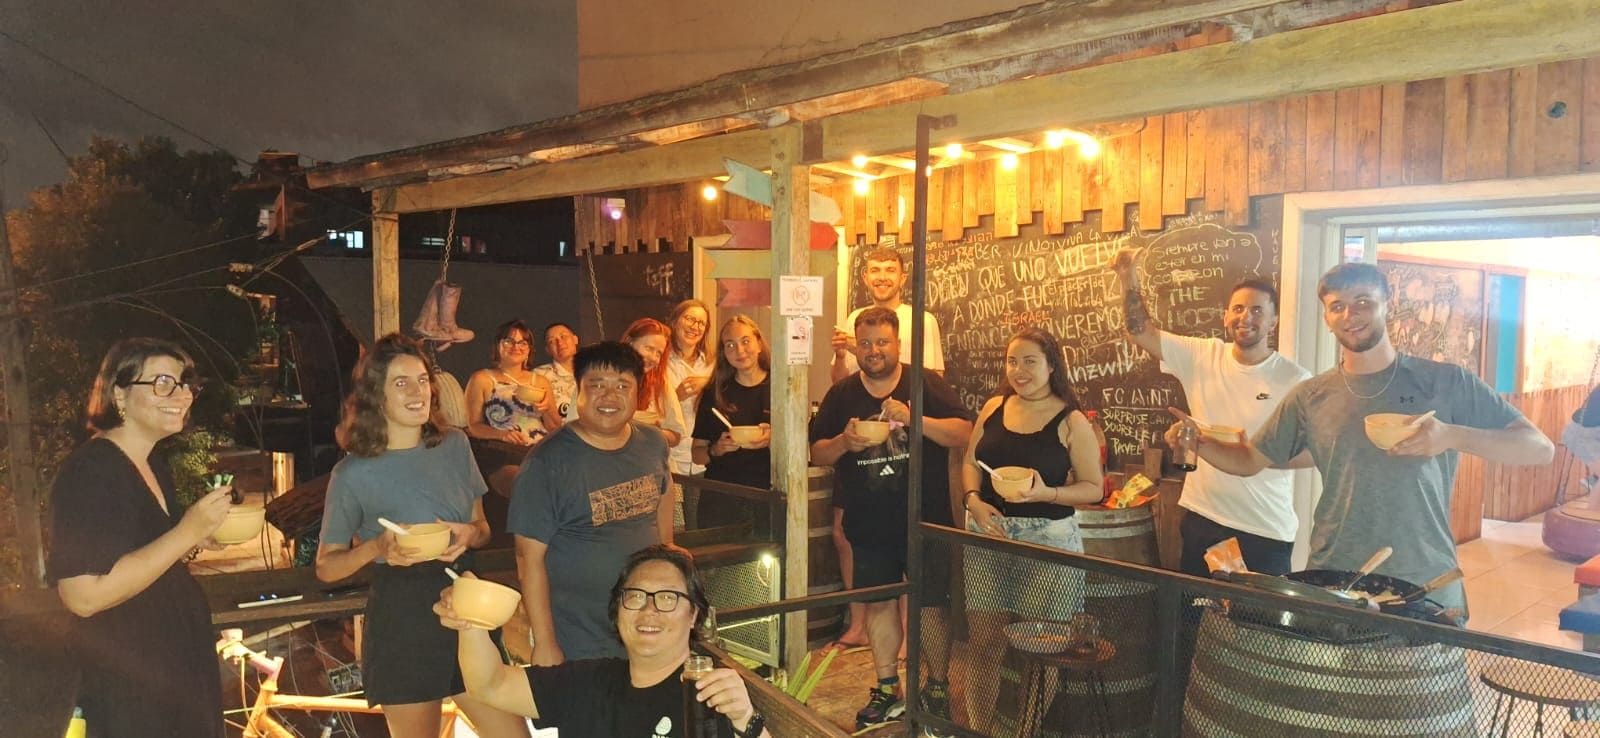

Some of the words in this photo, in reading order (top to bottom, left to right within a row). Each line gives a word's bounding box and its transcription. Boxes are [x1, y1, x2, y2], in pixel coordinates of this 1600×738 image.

[979, 265, 1006, 296] QUE
[1013, 256, 1046, 282] UNO
[1169, 285, 1211, 307] THE
[954, 304, 967, 330] A
[968, 288, 1014, 321] DONDE
[1102, 387, 1125, 404] FC
[1103, 408, 1149, 425] SURPRISE
